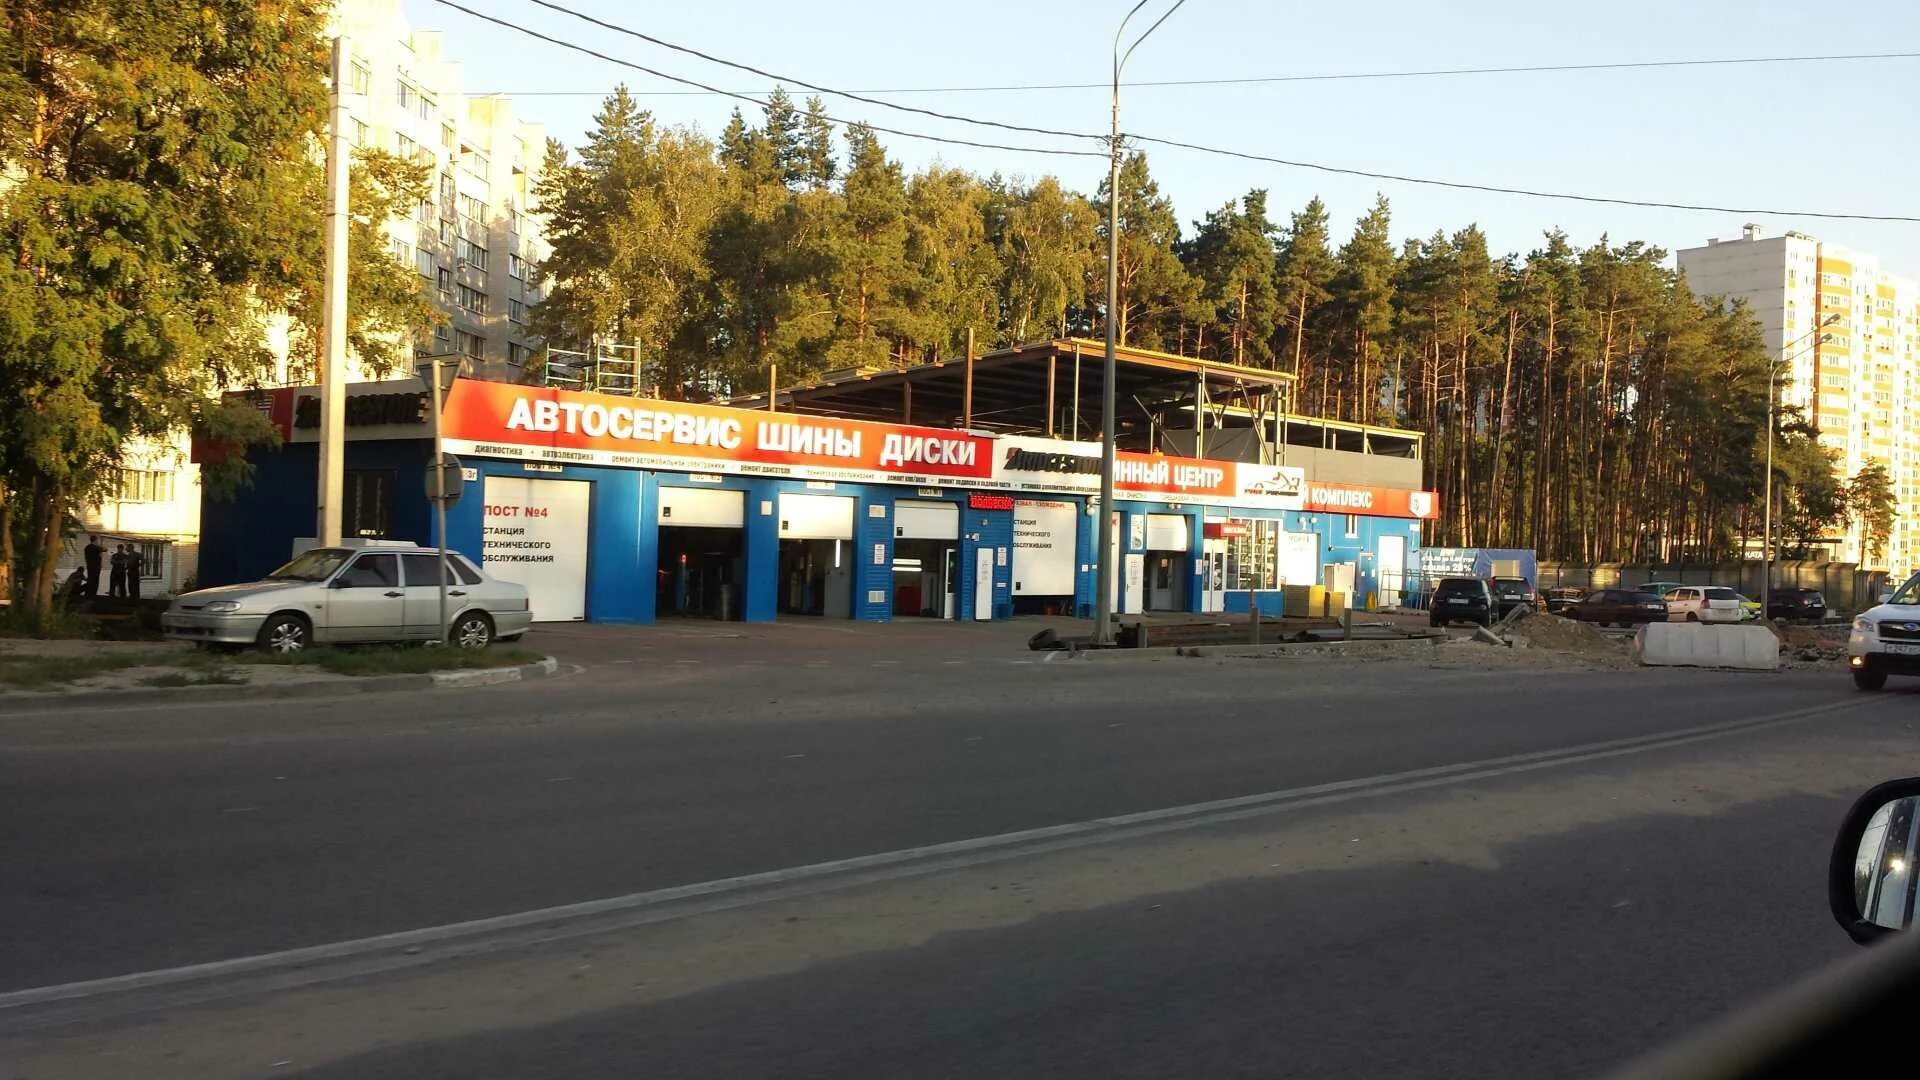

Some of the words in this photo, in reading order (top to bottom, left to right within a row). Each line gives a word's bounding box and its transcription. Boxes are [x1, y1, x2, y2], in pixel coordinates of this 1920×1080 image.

[505, 396, 742, 450] АВТОСЕРВИС
[755, 421, 862, 458] ШИНЫ
[879, 432, 977, 468] ДИСКИ
[1113, 459, 1169, 485] ИННЫЙ
[1173, 464, 1224, 491] ЦЕНТР
[1311, 487, 1373, 509] КОМПЛЕКС
[484, 505, 520, 518] ПОСТ
[524, 507, 549, 519] №4
[482, 527, 525, 537] СТАНЦИЯ
[482, 540, 552, 551] ТЕХНИЧЕСКОГО
[482, 554, 555, 564] ОБСЛУЖИВАНИЯ
